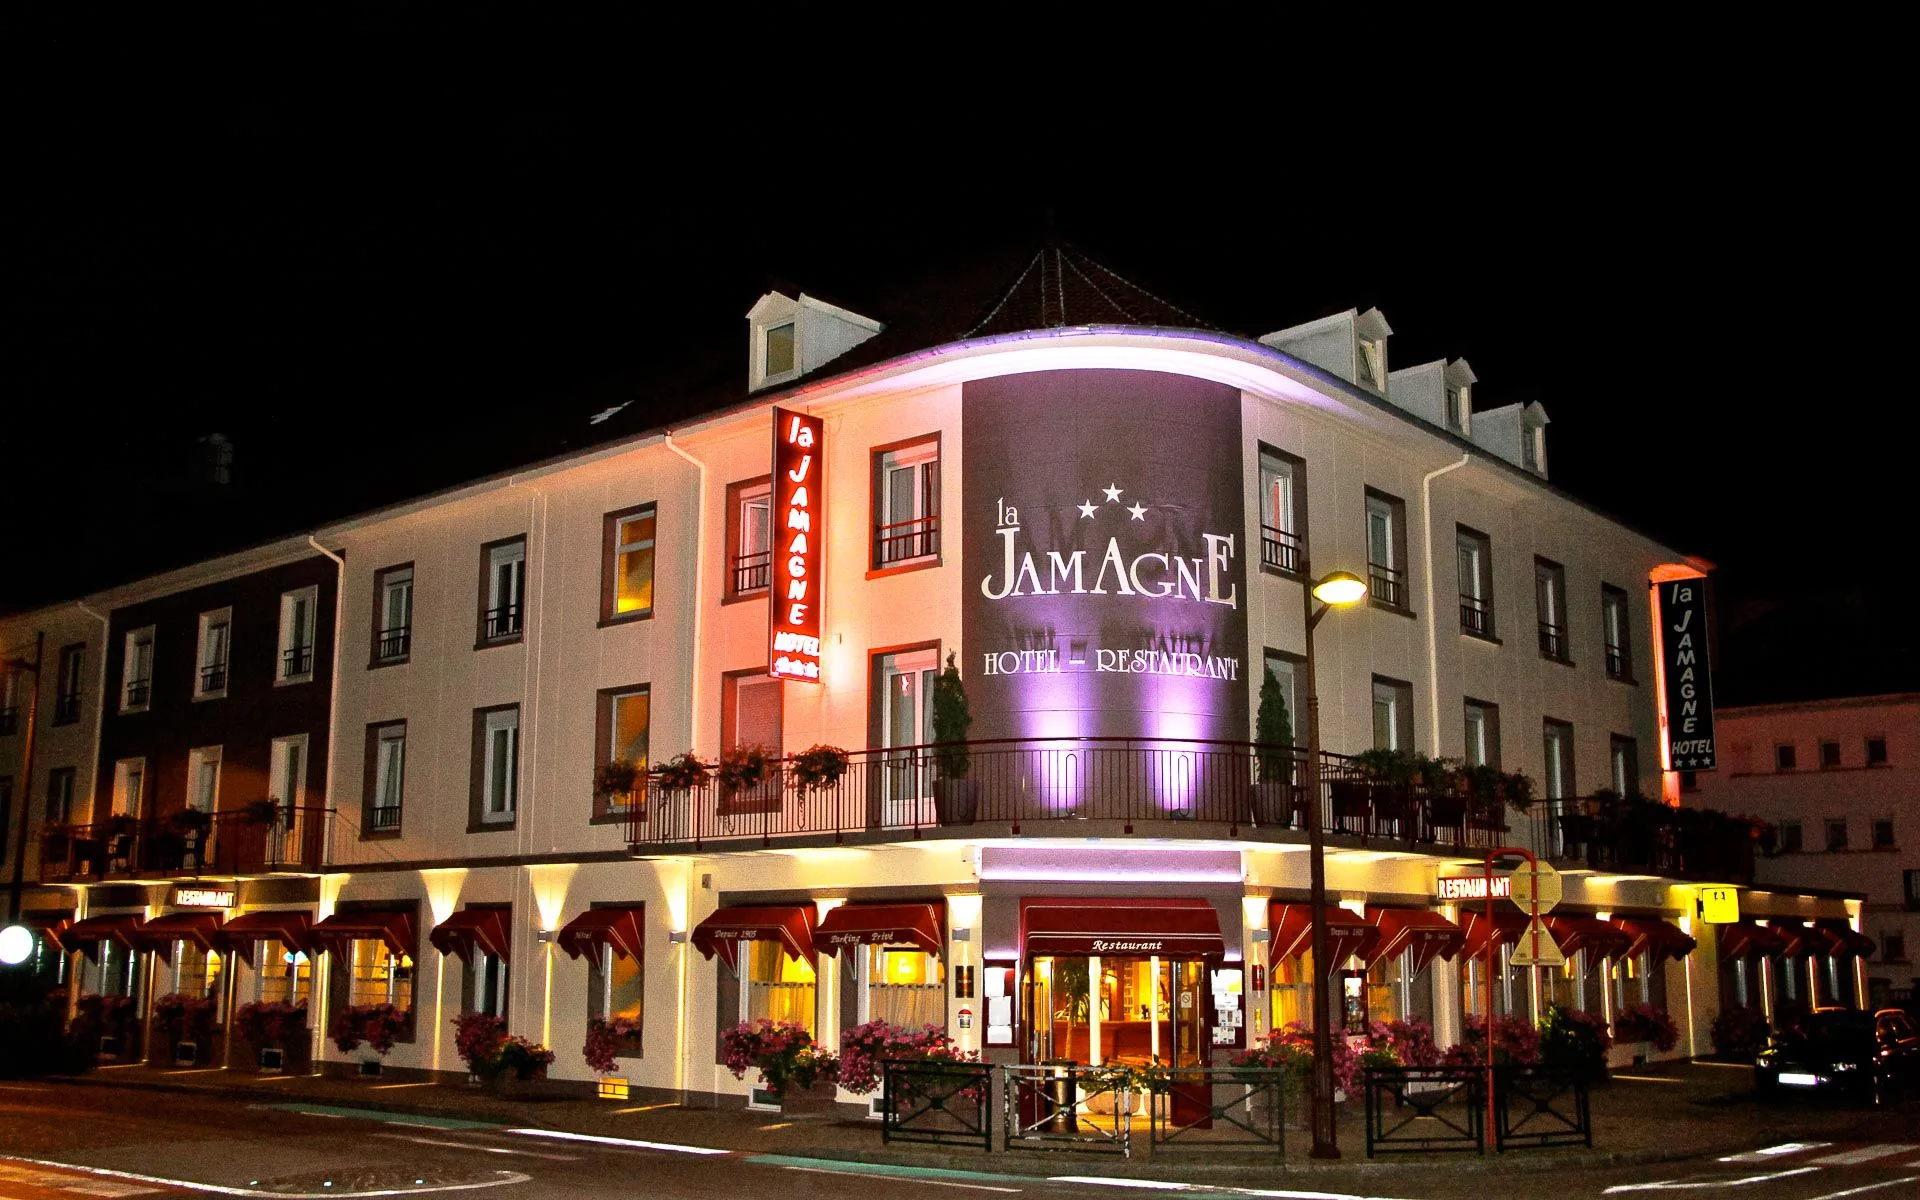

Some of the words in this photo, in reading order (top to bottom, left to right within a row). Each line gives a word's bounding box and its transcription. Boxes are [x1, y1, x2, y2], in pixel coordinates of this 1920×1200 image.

[789, 416, 814, 447] la
[997, 497, 1020, 526] la
[788, 455, 811, 625] JAMAGNE
[981, 527, 1237, 610] JAMAGNE
[1671, 583, 1692, 605] la
[983, 649, 1061, 676] HOTEL
[1095, 648, 1239, 681] RESTAURANT
[1673, 609, 1698, 734] JAMAGNE
[1671, 739, 1713, 756] HOTEL
[830, 932, 861, 945] Parking
[1092, 940, 1162, 951] Restaurant
